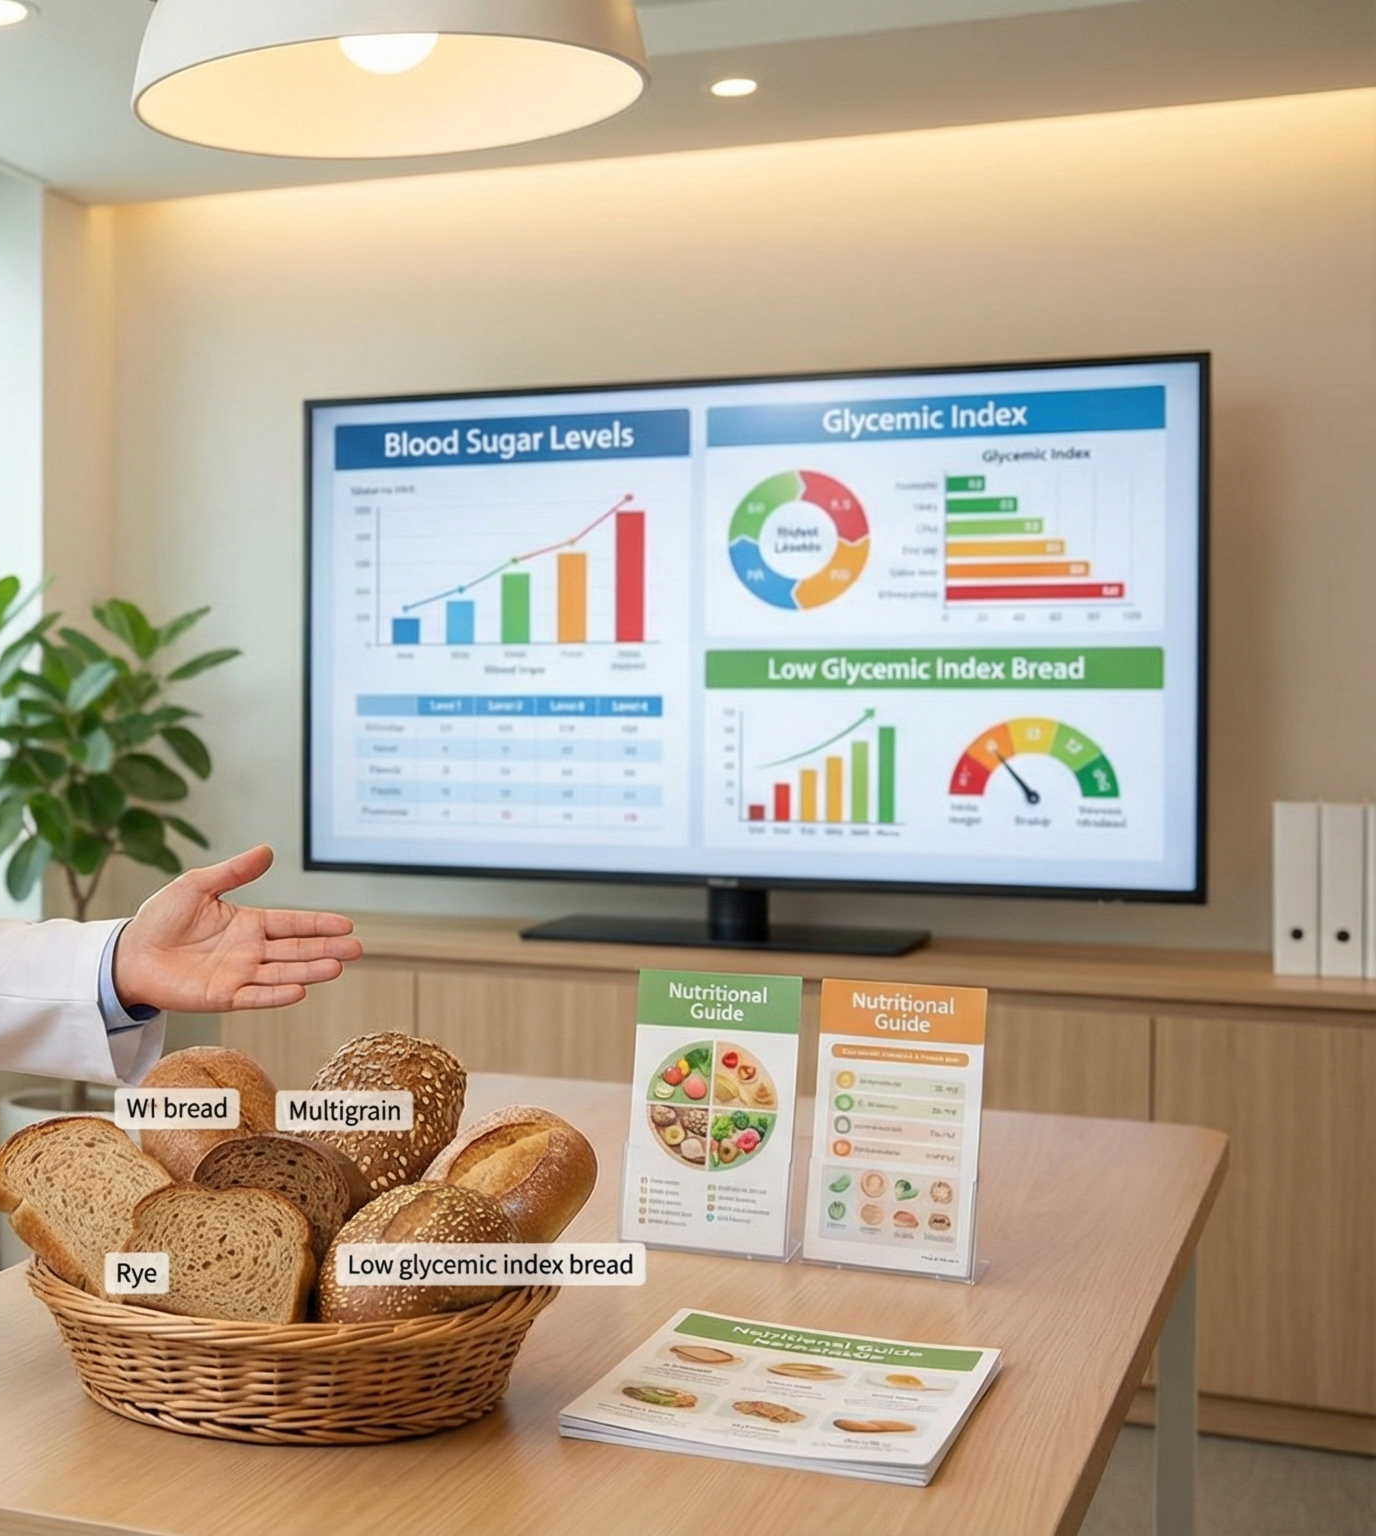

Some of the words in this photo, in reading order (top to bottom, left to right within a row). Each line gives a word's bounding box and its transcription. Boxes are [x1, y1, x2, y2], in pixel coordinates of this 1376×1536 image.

[822, 405, 944, 439] Glycemic
[951, 400, 1028, 428] Index
[384, 429, 460, 458] Blood
[466, 426, 543, 460] Sugar
[549, 420, 634, 451] Levels
[982, 449, 1046, 465] Glycemic
[1050, 447, 1092, 461] Index
[768, 657, 817, 680] Low
[821, 656, 931, 686] Glycemic
[936, 655, 1006, 680] Index
[1011, 655, 1086, 680] Bread
[669, 982, 767, 1004] Nutritional
[852, 991, 954, 1015] Nutritional
[690, 1003, 744, 1021] Guide
[874, 1013, 931, 1033] Guide
